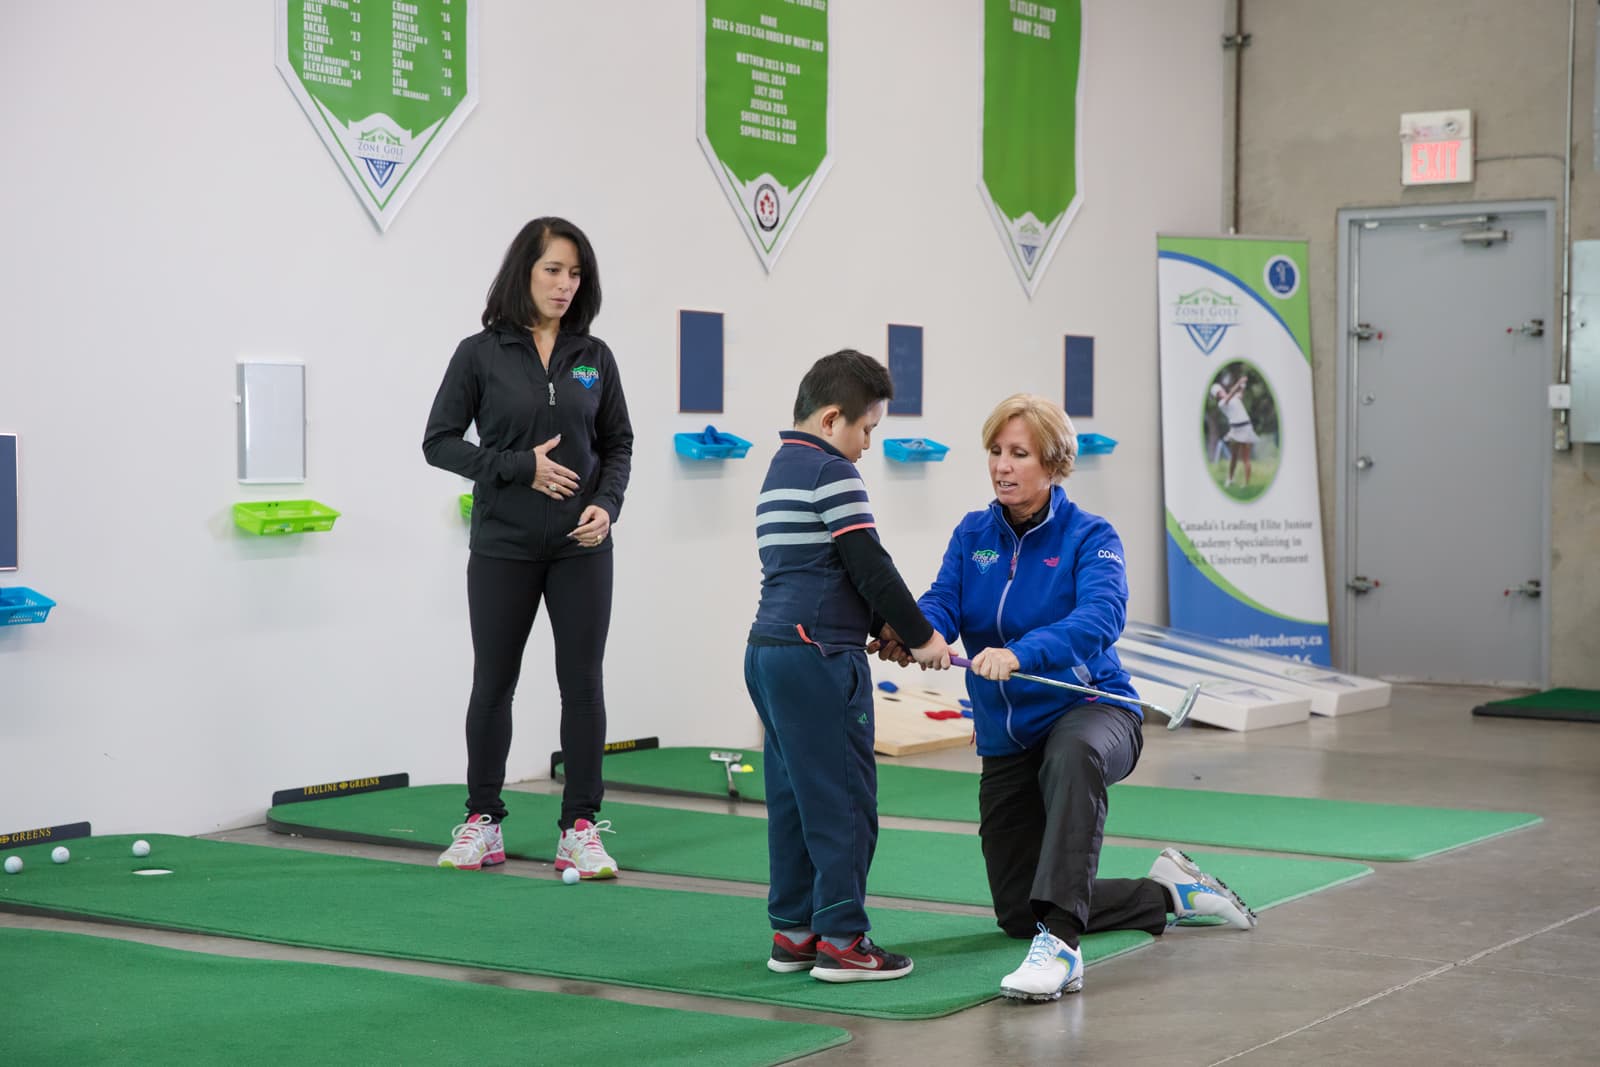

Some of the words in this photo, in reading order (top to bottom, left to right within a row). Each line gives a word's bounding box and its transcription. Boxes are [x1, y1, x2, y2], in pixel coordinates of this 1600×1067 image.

[303, 2, 323, 14] JULIE
[303, 21, 330, 35] RACHEL
[392, 39, 416, 53] ASHLEY
[303, 61, 342, 77] ALEXANDER
[358, 142, 379, 153] ZONE
[383, 145, 404, 156] GOLF
[1410, 140, 1461, 182] EXIT
[1175, 306, 1204, 317] ZONE
[1208, 306, 1239, 318] GOLF
[1178, 519, 1219, 531] Canada's
[1221, 519, 1258, 534] Leading
[1260, 519, 1281, 530] Elite
[1283, 519, 1313, 532] Junior
[1189, 537, 1232, 551] Academy
[1234, 536, 1290, 551] Specializing
[1292, 536, 1302, 547] in
[1097, 549, 1121, 563] COAC
[1210, 554, 1258, 566] University
[1260, 552, 1309, 564] Placement
[304, 782, 337, 796] TRULINE
[349, 776, 380, 789] GREENS
[12, 827, 52, 843] GREENS
